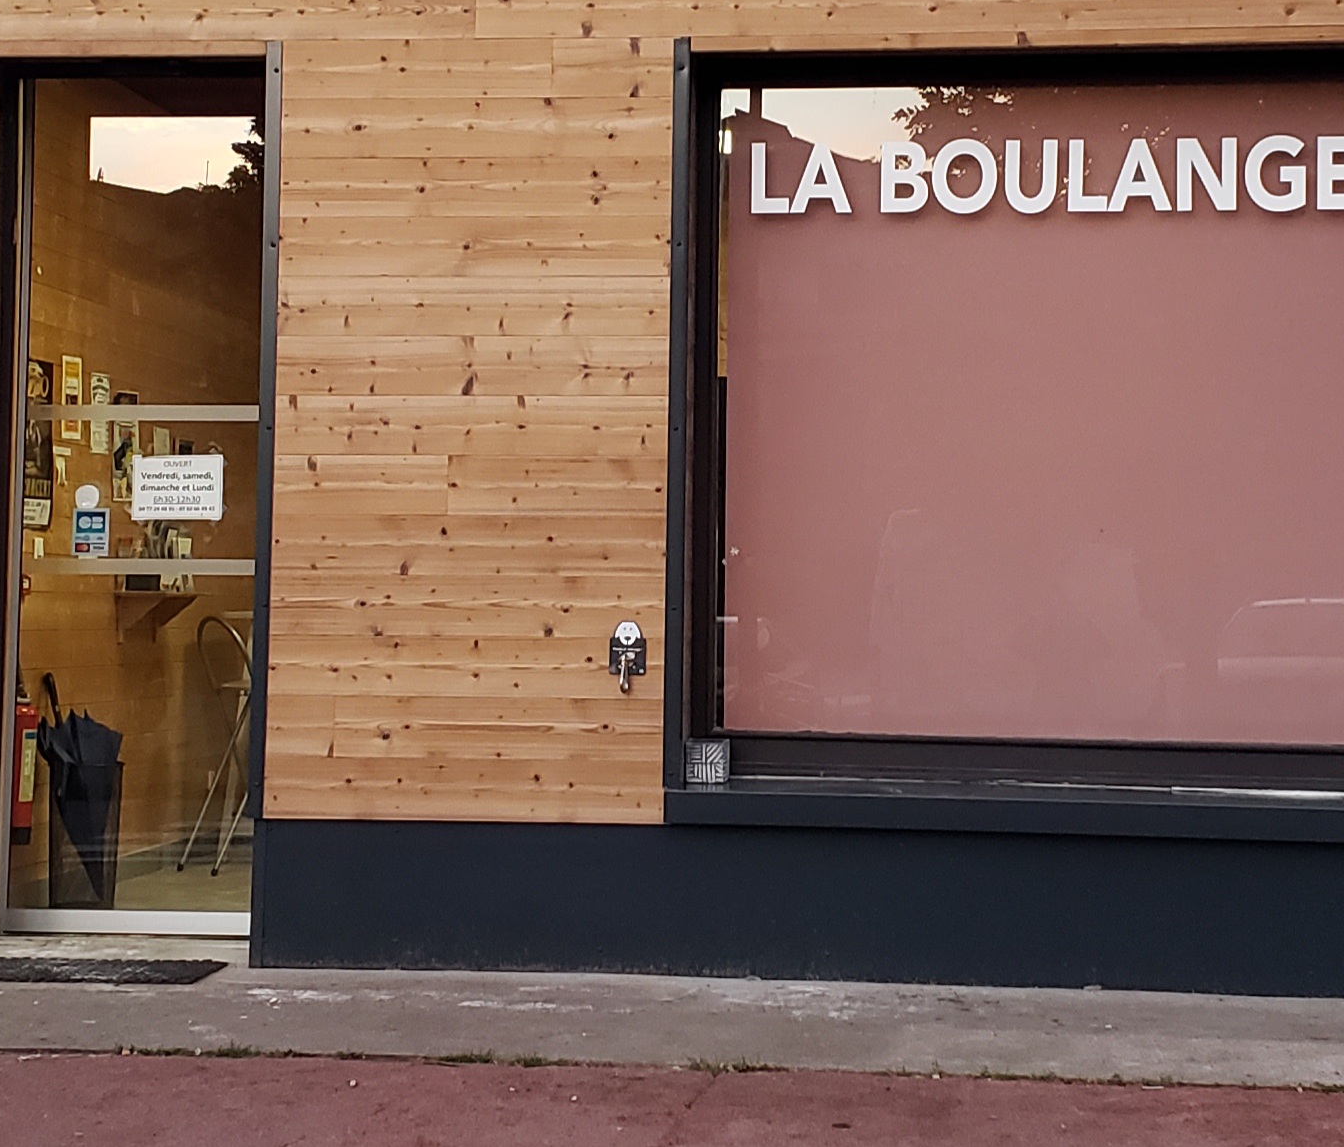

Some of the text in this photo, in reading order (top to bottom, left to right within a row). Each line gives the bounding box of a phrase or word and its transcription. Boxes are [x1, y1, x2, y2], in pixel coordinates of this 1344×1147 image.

[750, 141, 852, 215] LA
[163, 460, 193, 468] OUVERT
[141, 472, 214, 481] Vendredi, samedi,
[140, 484, 215, 492] dimanche et Lundi
[78, 516, 104, 529] CB
